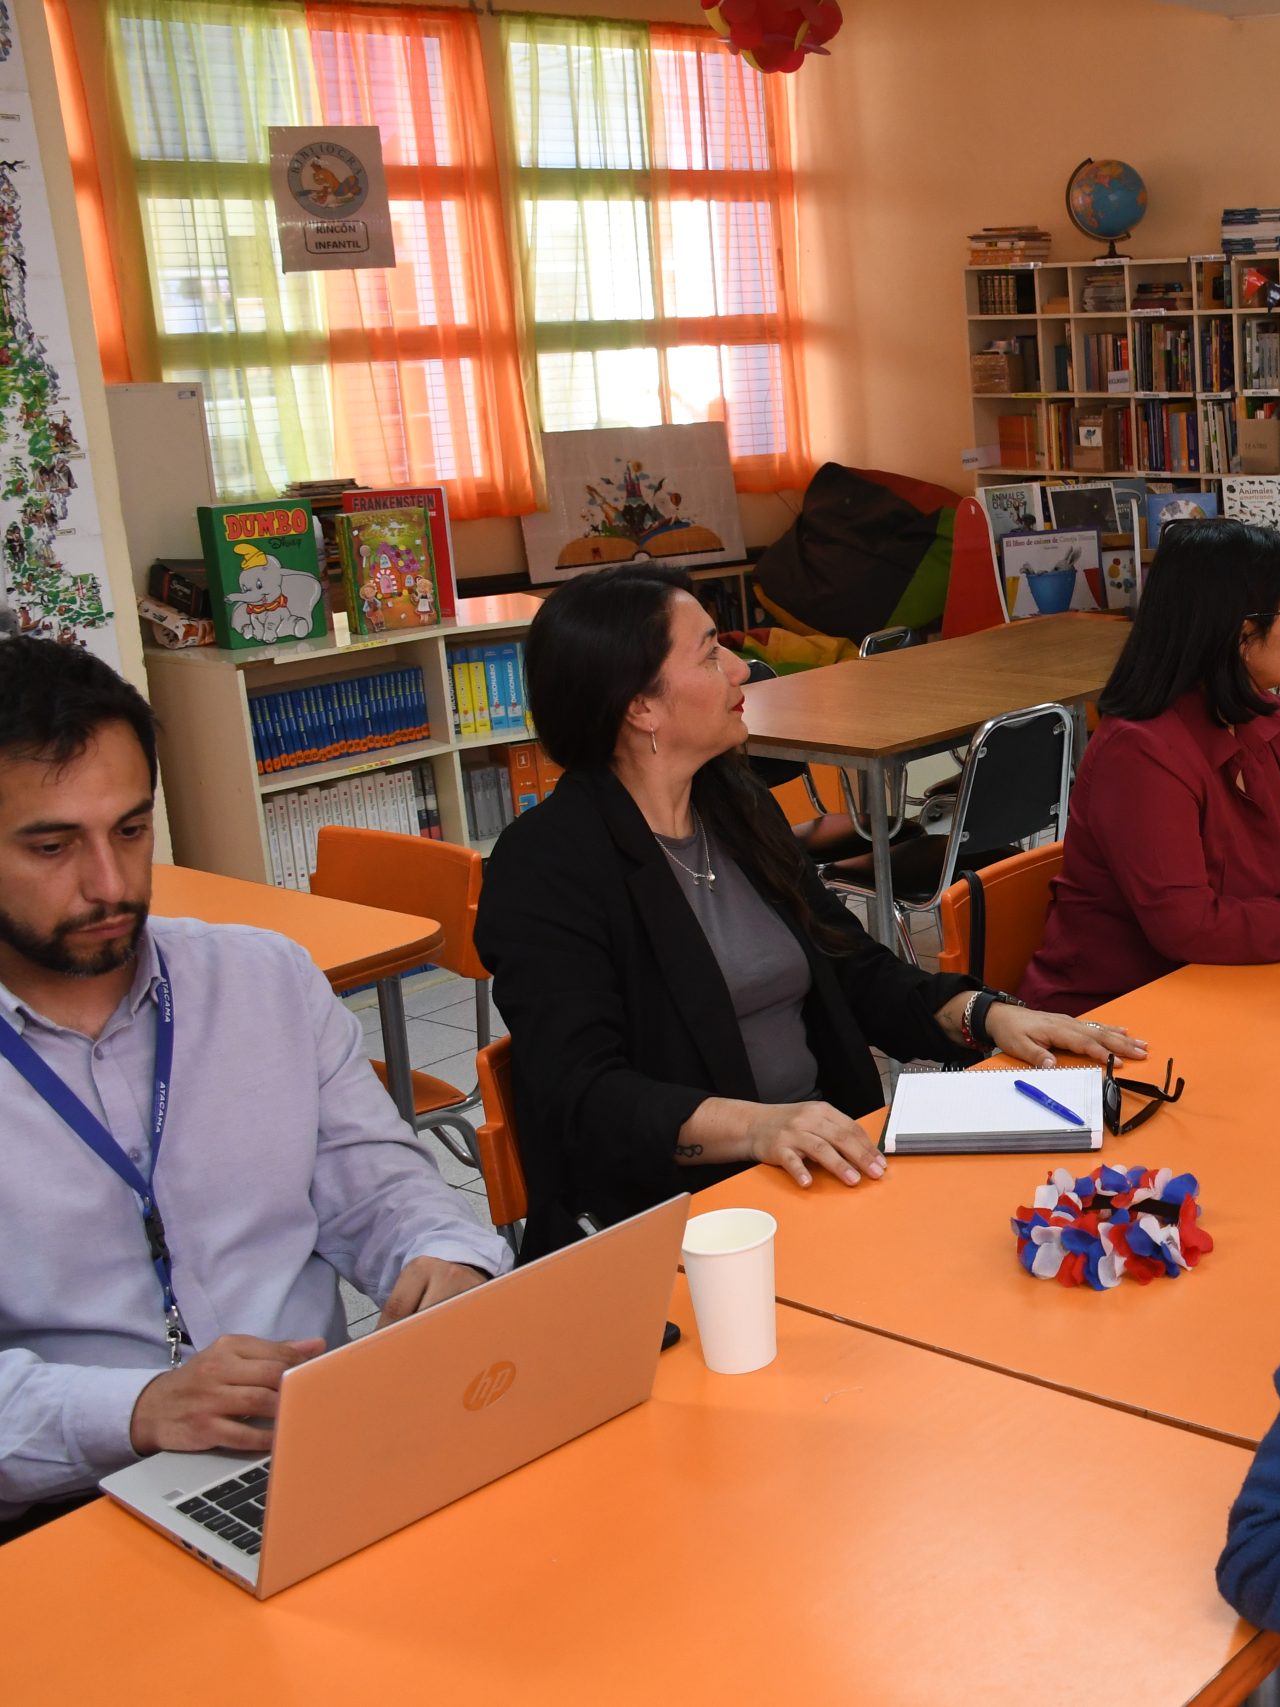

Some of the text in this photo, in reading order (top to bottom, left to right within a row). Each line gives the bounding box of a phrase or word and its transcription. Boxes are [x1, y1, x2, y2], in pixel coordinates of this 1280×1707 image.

[316, 224, 356, 234] RINCÓN
[315, 240, 360, 250] INFANTIL
[991, 491, 1025, 501] ANIMALES
[1239, 487, 1274, 495] Animales
[352, 494, 435, 513] FRANKENSTEIN
[225, 508, 308, 541] DUMBO
[1026, 537, 1033, 545] de
[1052, 536, 1059, 544] de
[489, 663, 500, 705] DICCIONARIO
[507, 660, 517, 704] DICCIONARIO
[520, 754, 528, 767] 1
[161, 977, 171, 1023] ATACAMA
[155, 1081, 166, 1133] ATACAMA
[465, 1362, 517, 1412] hp
